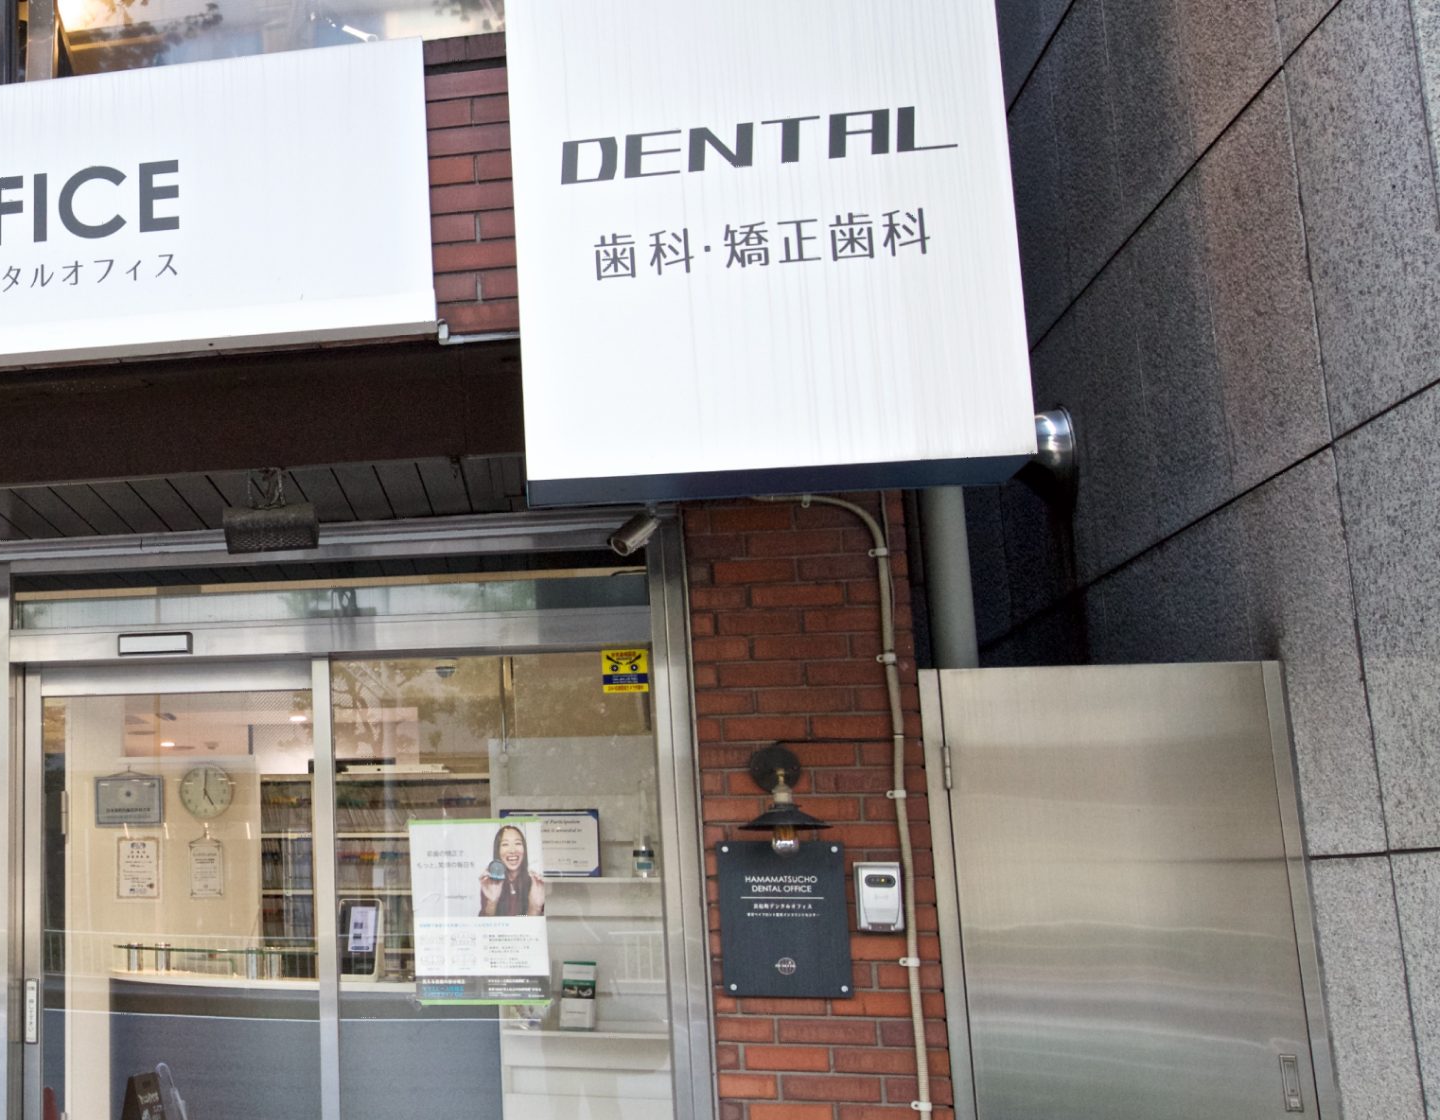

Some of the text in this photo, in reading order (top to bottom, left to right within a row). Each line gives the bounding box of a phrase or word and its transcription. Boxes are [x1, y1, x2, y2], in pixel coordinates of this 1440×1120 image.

[561, 106, 958, 185] DENTAL
[744, 875, 818, 883] HAMAMATSUCHO
[751, 884, 812, 893] DENTAL OFFICE
